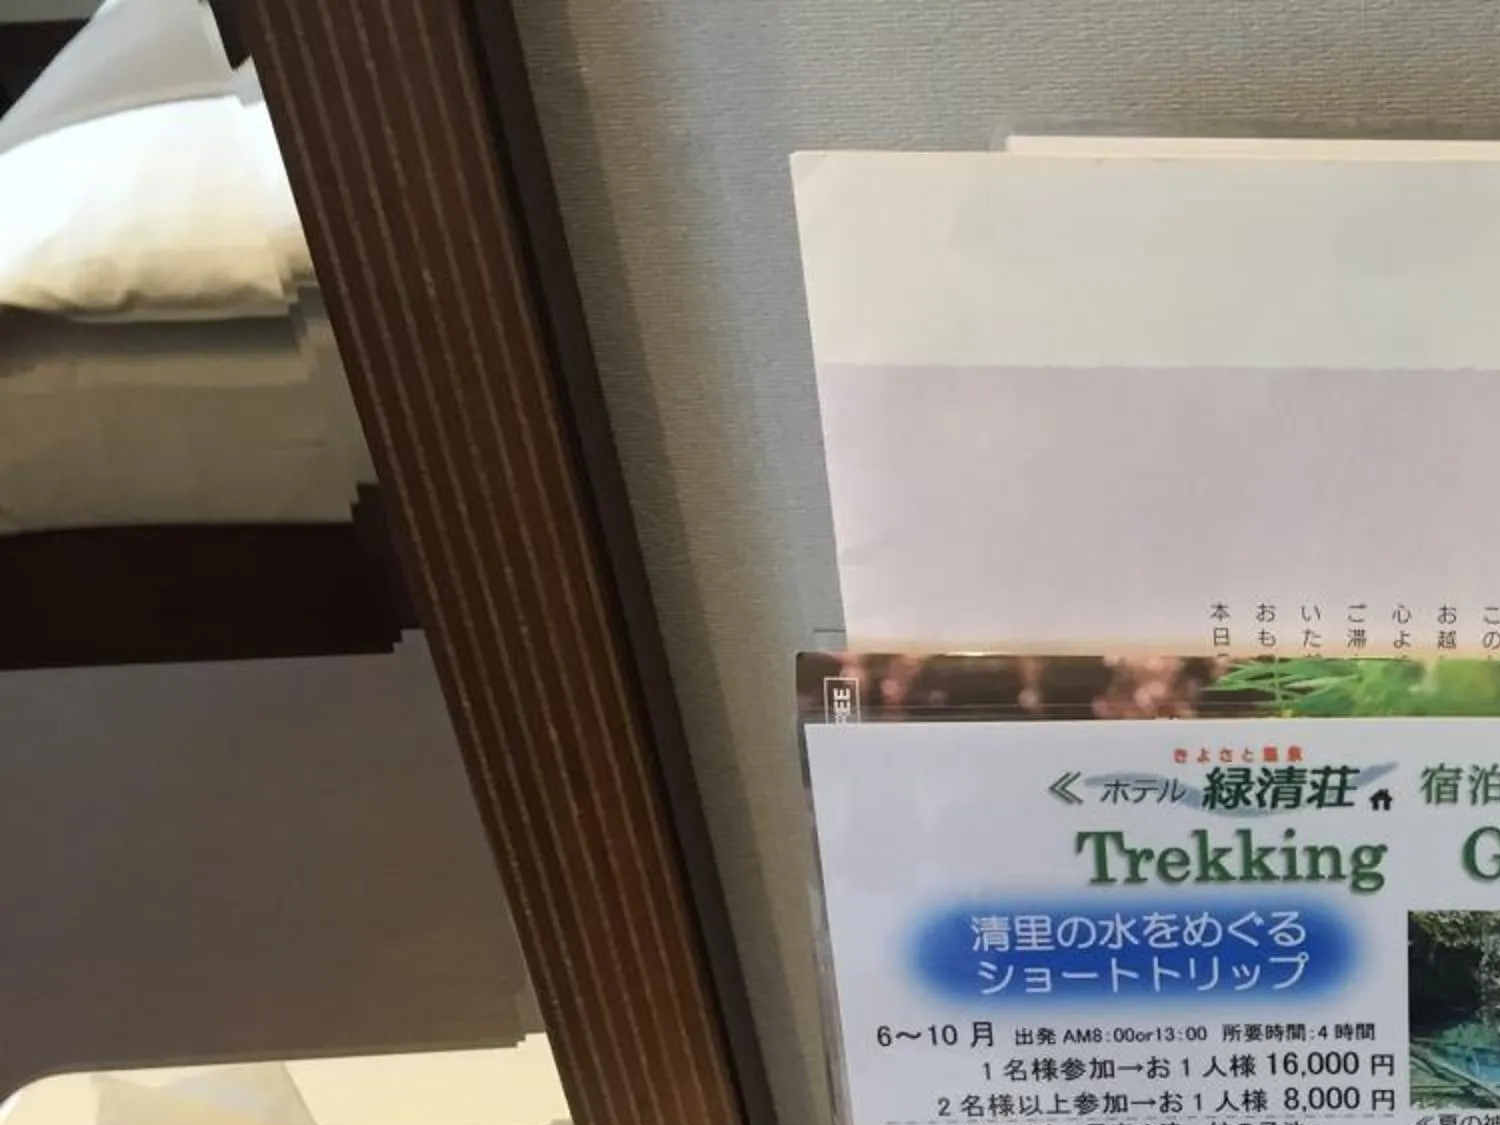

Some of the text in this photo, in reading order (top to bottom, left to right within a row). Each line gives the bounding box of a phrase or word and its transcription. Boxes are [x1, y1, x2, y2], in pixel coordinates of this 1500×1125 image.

[1209, 603, 1231, 656] 本日
[1256, 603, 1277, 656] おも
[1301, 604, 1321, 656] いた
[1347, 603, 1368, 656] ご滞
[1392, 605, 1412, 656] 心よ
[1437, 605, 1457, 657] お越
[1075, 827, 1389, 894] Trekking
[971, 910, 1307, 952] 清里の水をめぐる
[977, 953, 1310, 995] ショートトリップ
